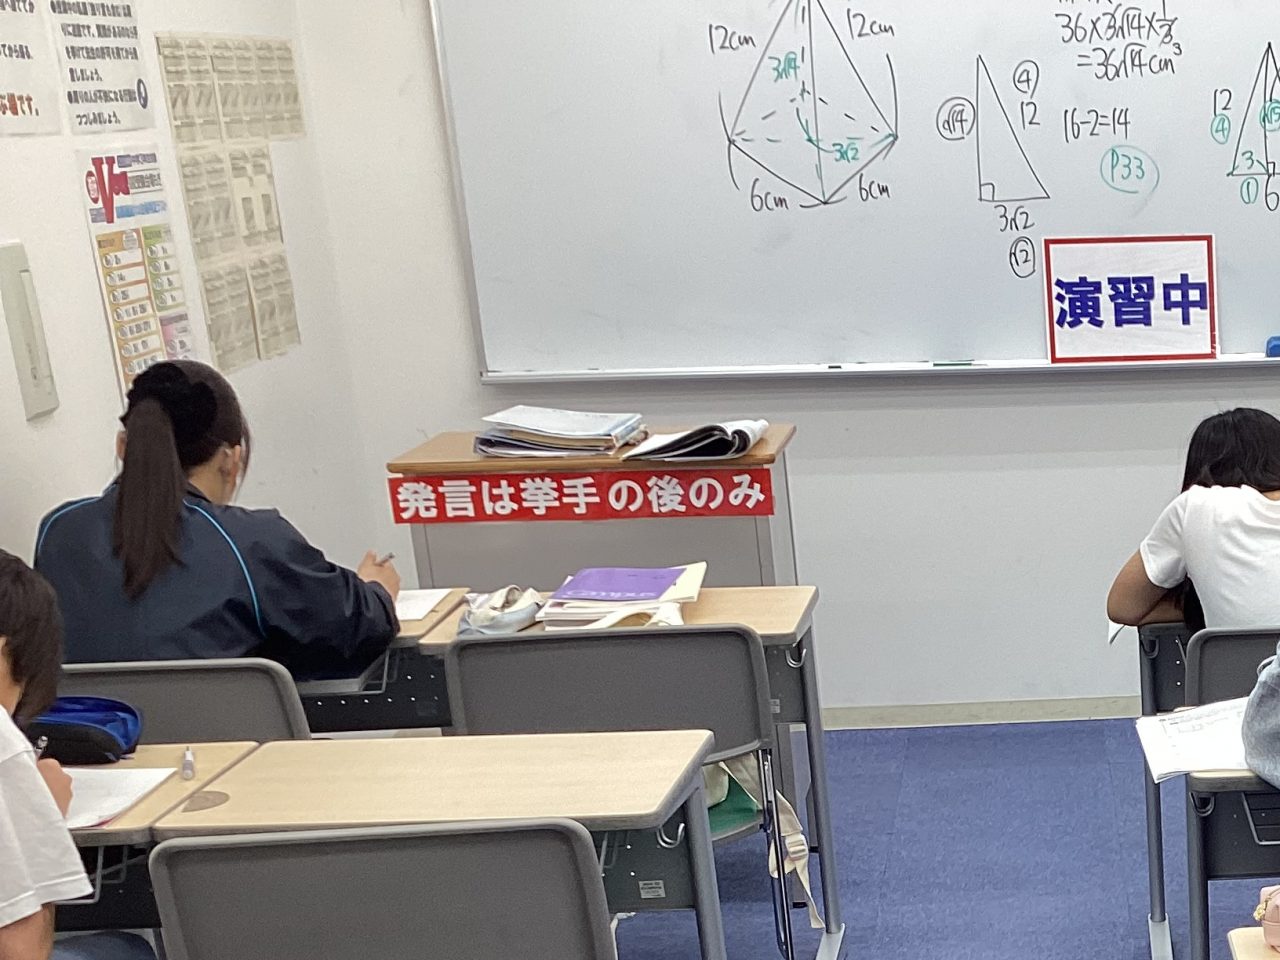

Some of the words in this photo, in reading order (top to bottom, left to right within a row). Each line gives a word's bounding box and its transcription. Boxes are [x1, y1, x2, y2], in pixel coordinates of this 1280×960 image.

[1054, 273, 1208, 329] 演習中
[396, 474, 766, 519] 発言は挙手の後のみ
